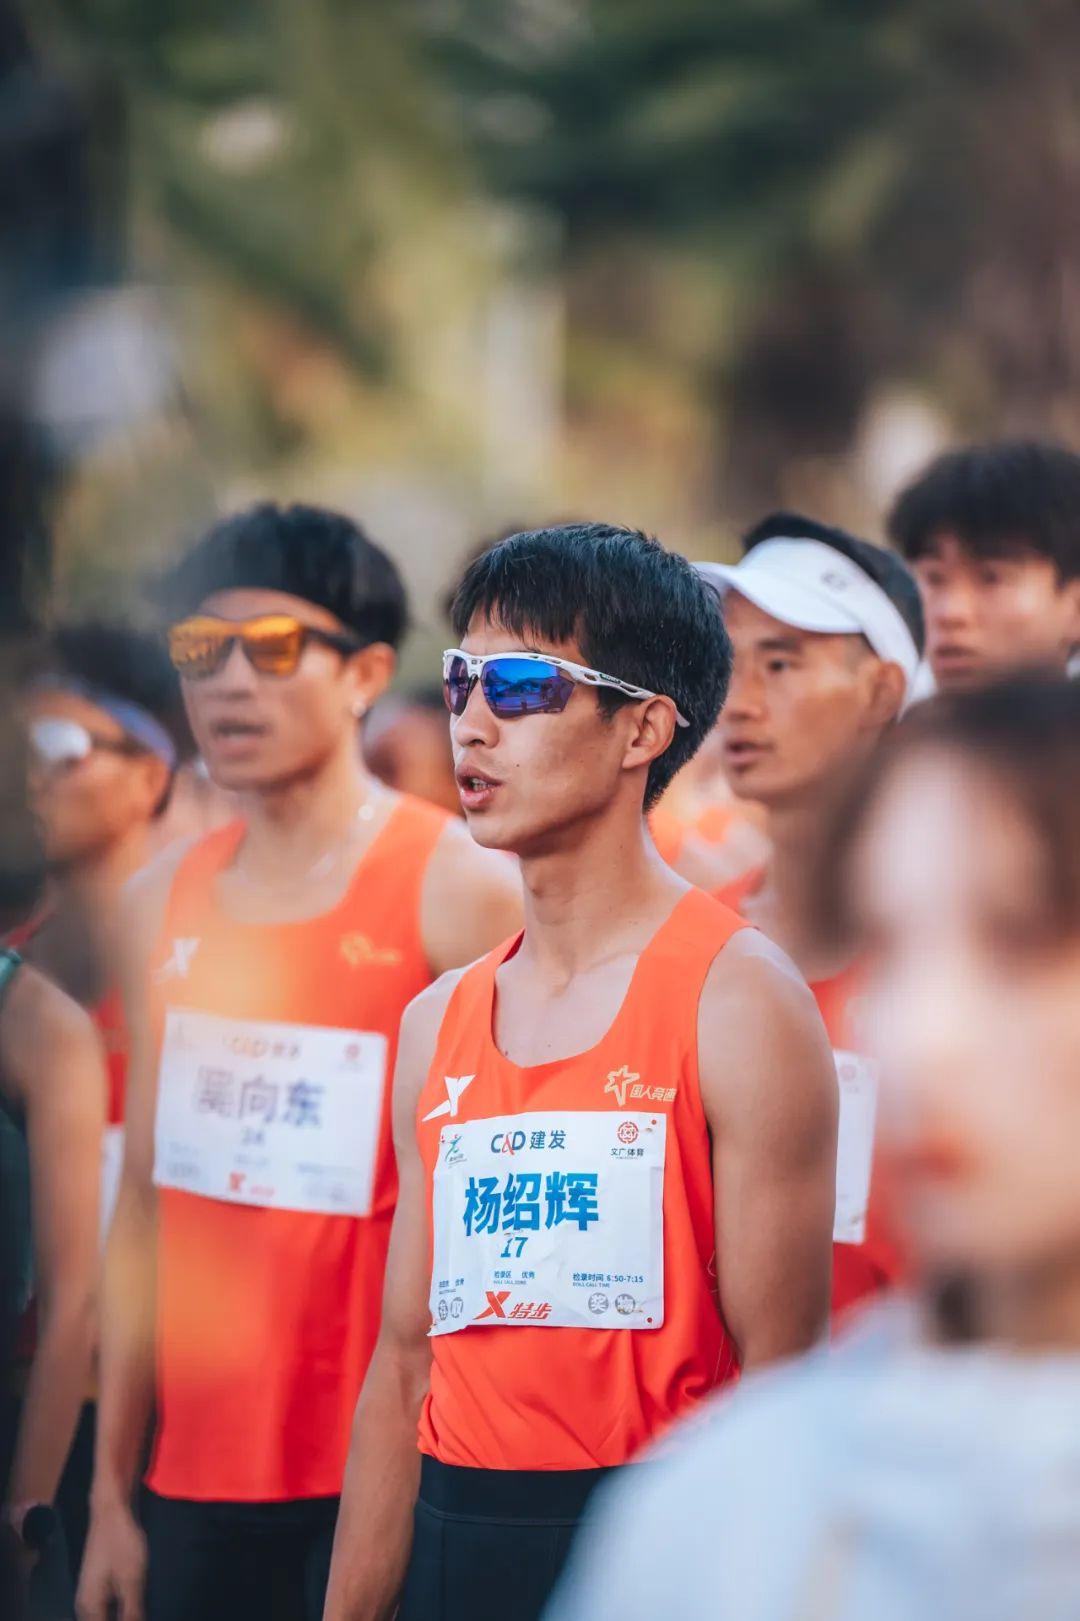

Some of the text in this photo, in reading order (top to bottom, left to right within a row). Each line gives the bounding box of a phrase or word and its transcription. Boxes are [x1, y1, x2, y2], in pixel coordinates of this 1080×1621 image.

[490, 1130, 566, 1155] C&D 建发
[611, 1148, 644, 1156] 文广体育
[463, 1171, 599, 1236] 杨绍辉
[500, 1236, 528, 1257] 17
[573, 1272, 644, 1283] 检录时间 6:50-7:15
